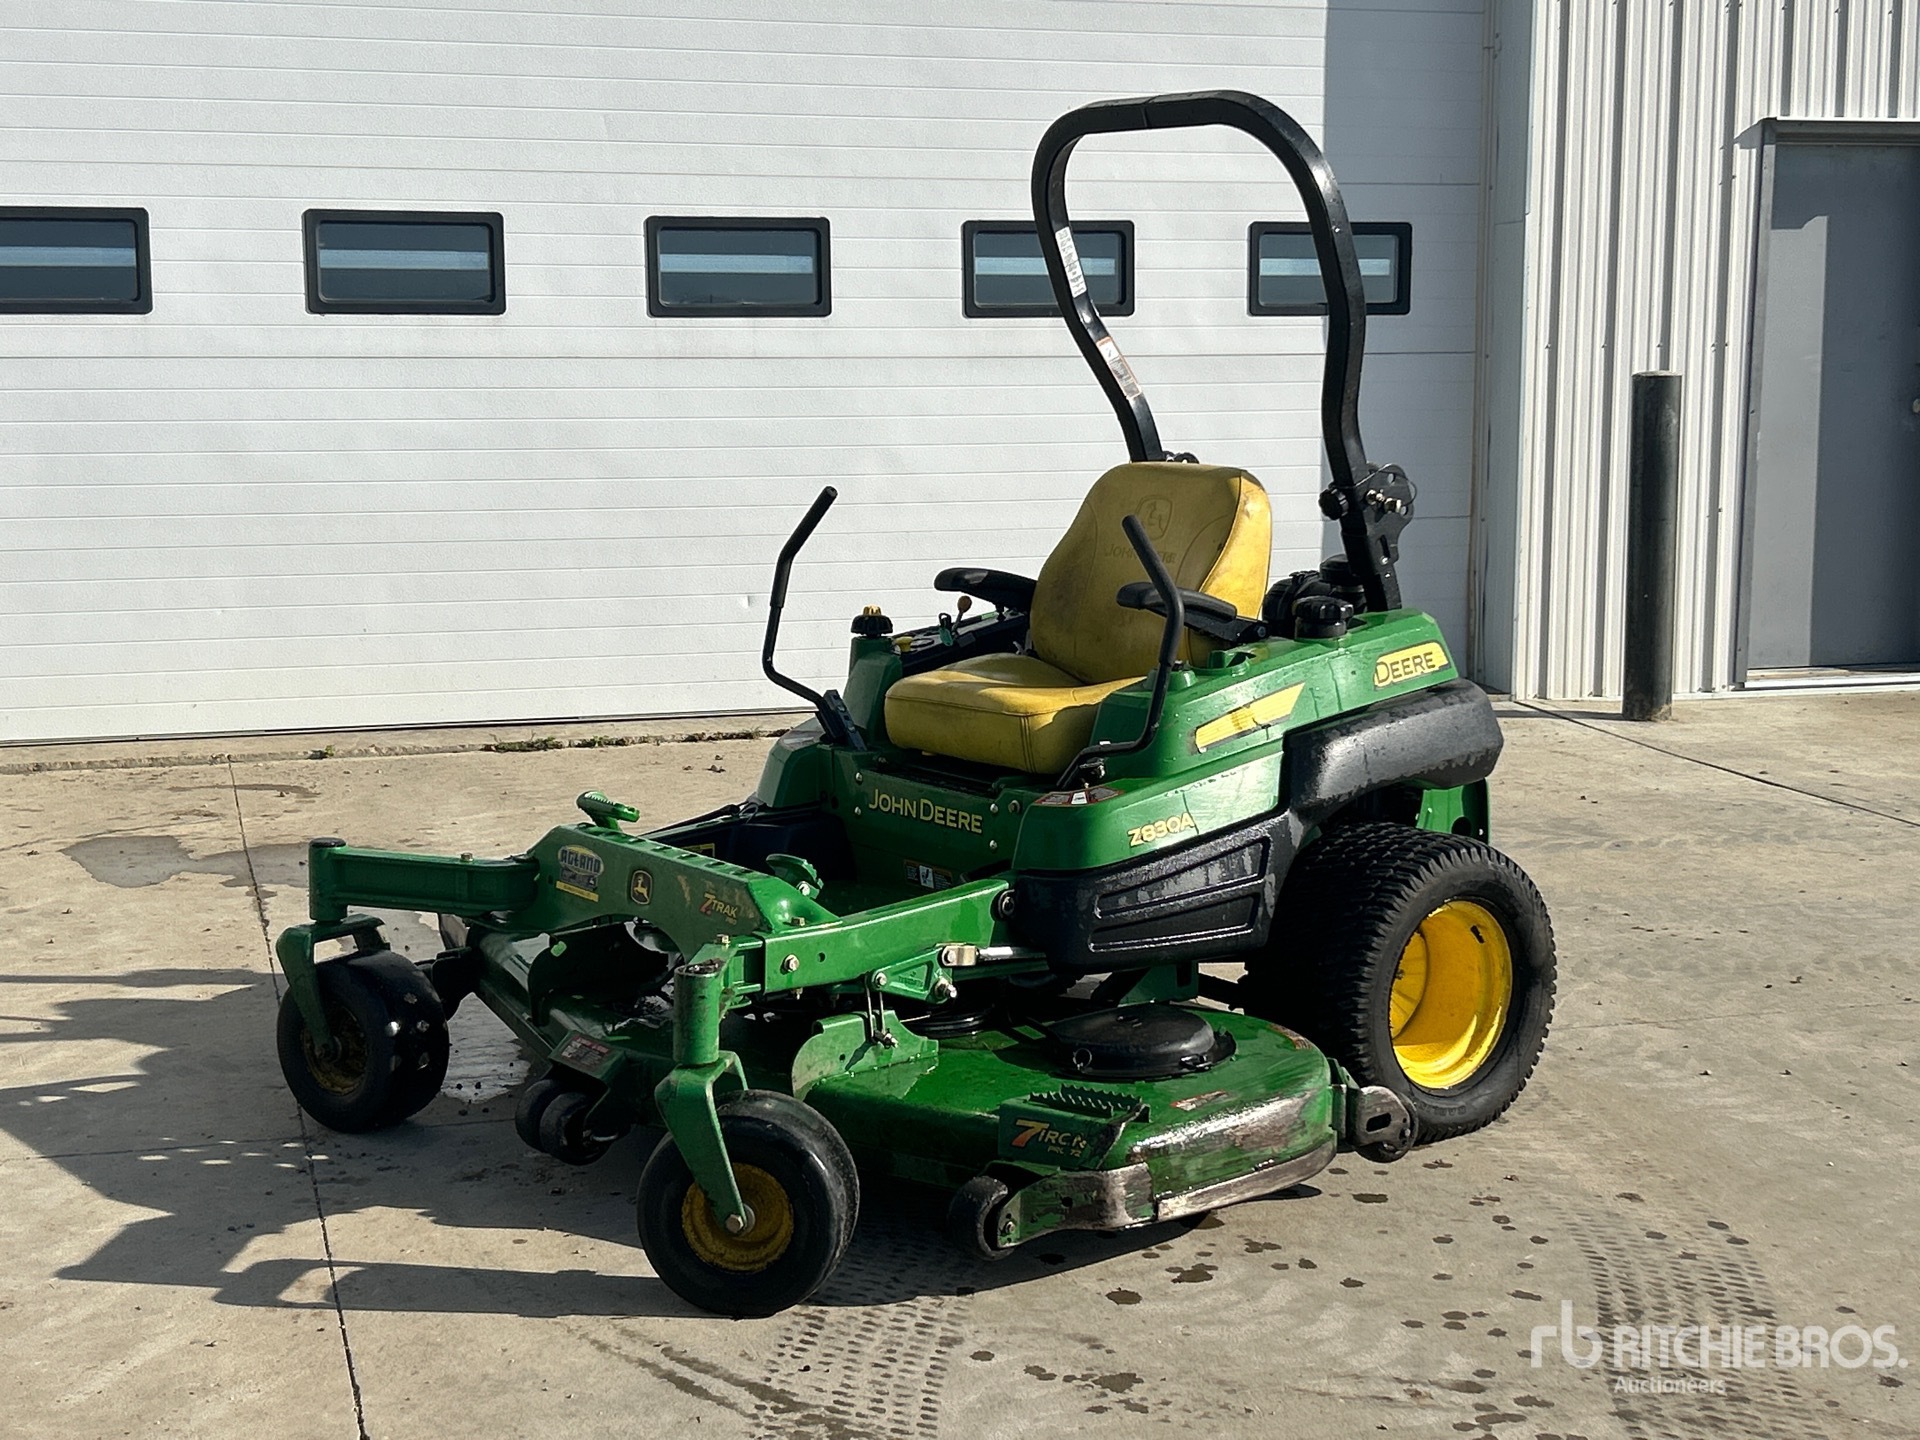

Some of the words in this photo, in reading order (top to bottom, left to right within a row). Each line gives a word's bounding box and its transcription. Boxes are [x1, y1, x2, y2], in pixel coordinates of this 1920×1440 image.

[1375, 651, 1436, 684] DEERE
[868, 788, 917, 818] JOHN
[919, 798, 983, 834] DEERE
[1127, 812, 1195, 847] Z830A
